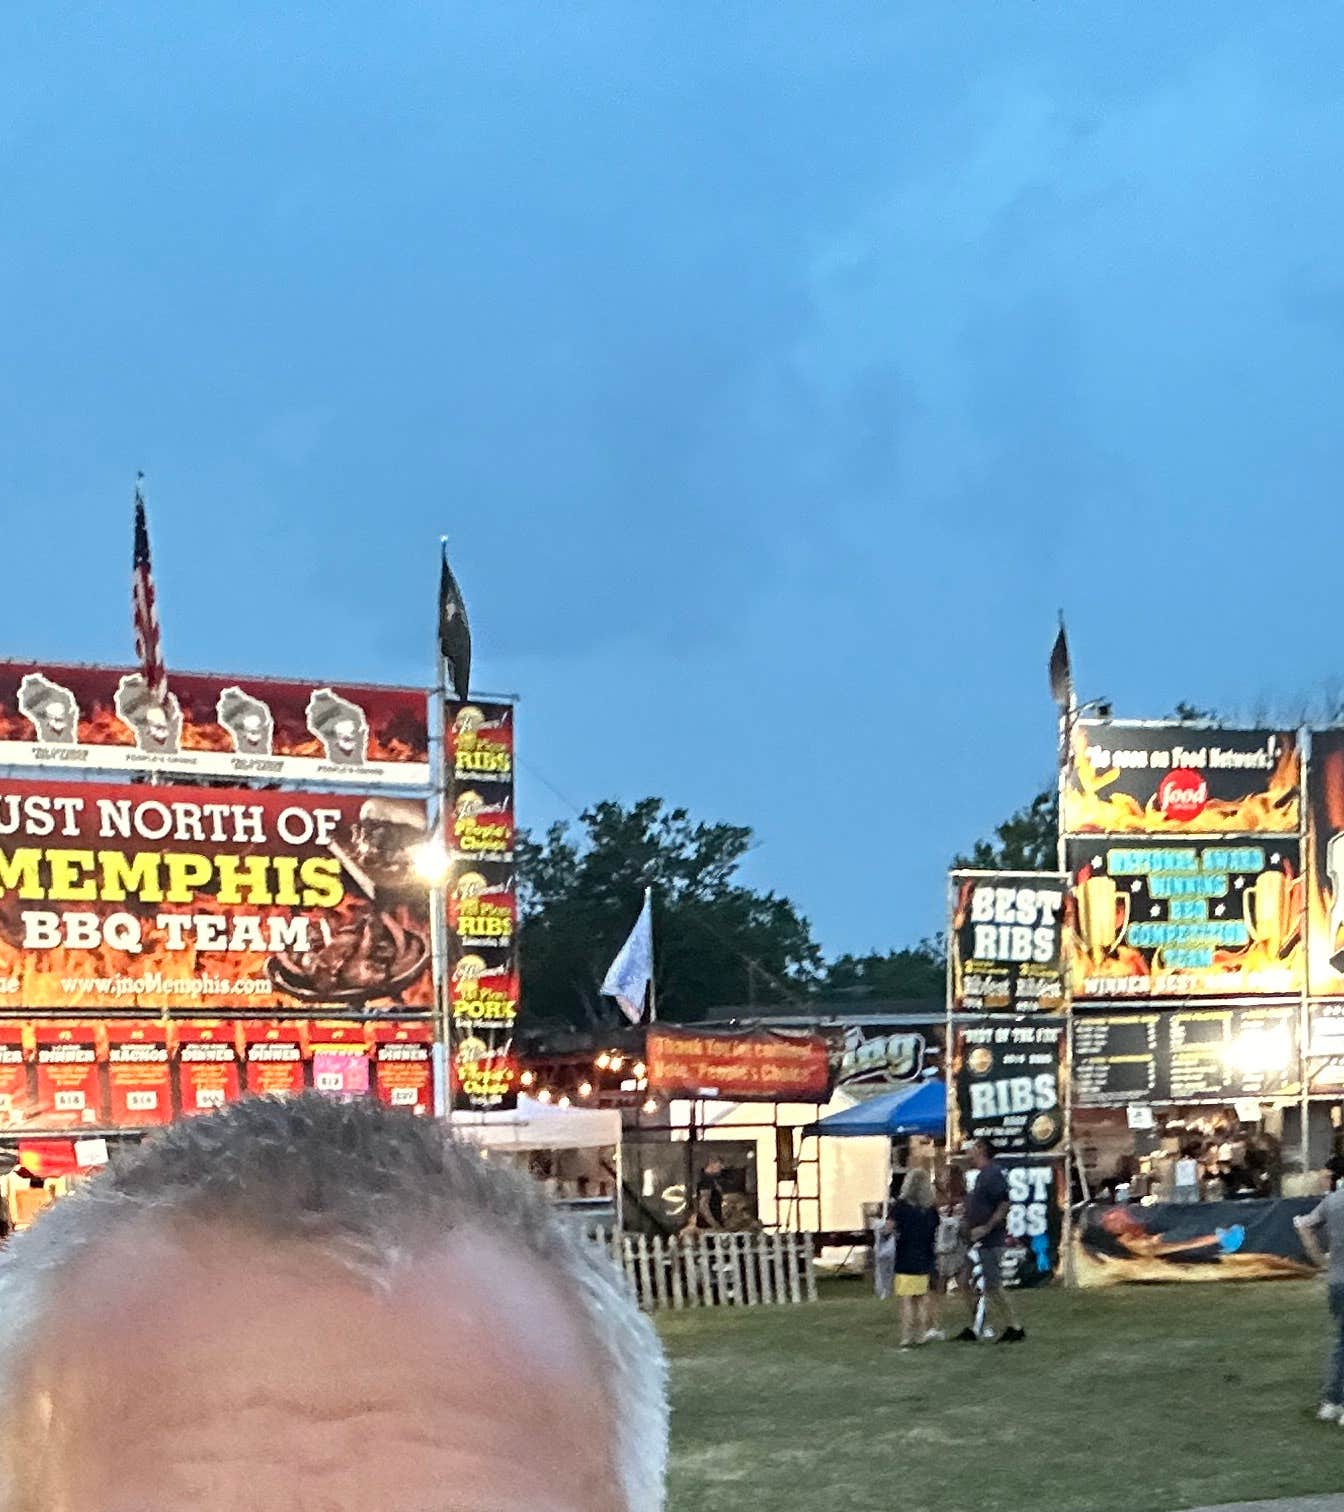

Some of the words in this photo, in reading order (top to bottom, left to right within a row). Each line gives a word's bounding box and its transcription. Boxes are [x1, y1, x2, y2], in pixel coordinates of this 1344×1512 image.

[456, 750, 511, 772] RIBS
[1161, 782, 1207, 810] food
[96, 800, 267, 844] NORTH
[276, 806, 342, 846] OF
[971, 886, 1063, 926] BEST
[21, 910, 144, 953] BBQ
[156, 914, 312, 953] TEAM
[457, 916, 513, 936] RIBS
[973, 925, 1056, 962] RIBS
[453, 1000, 517, 1018] PORK
[970, 1073, 1057, 1118] RIBS
